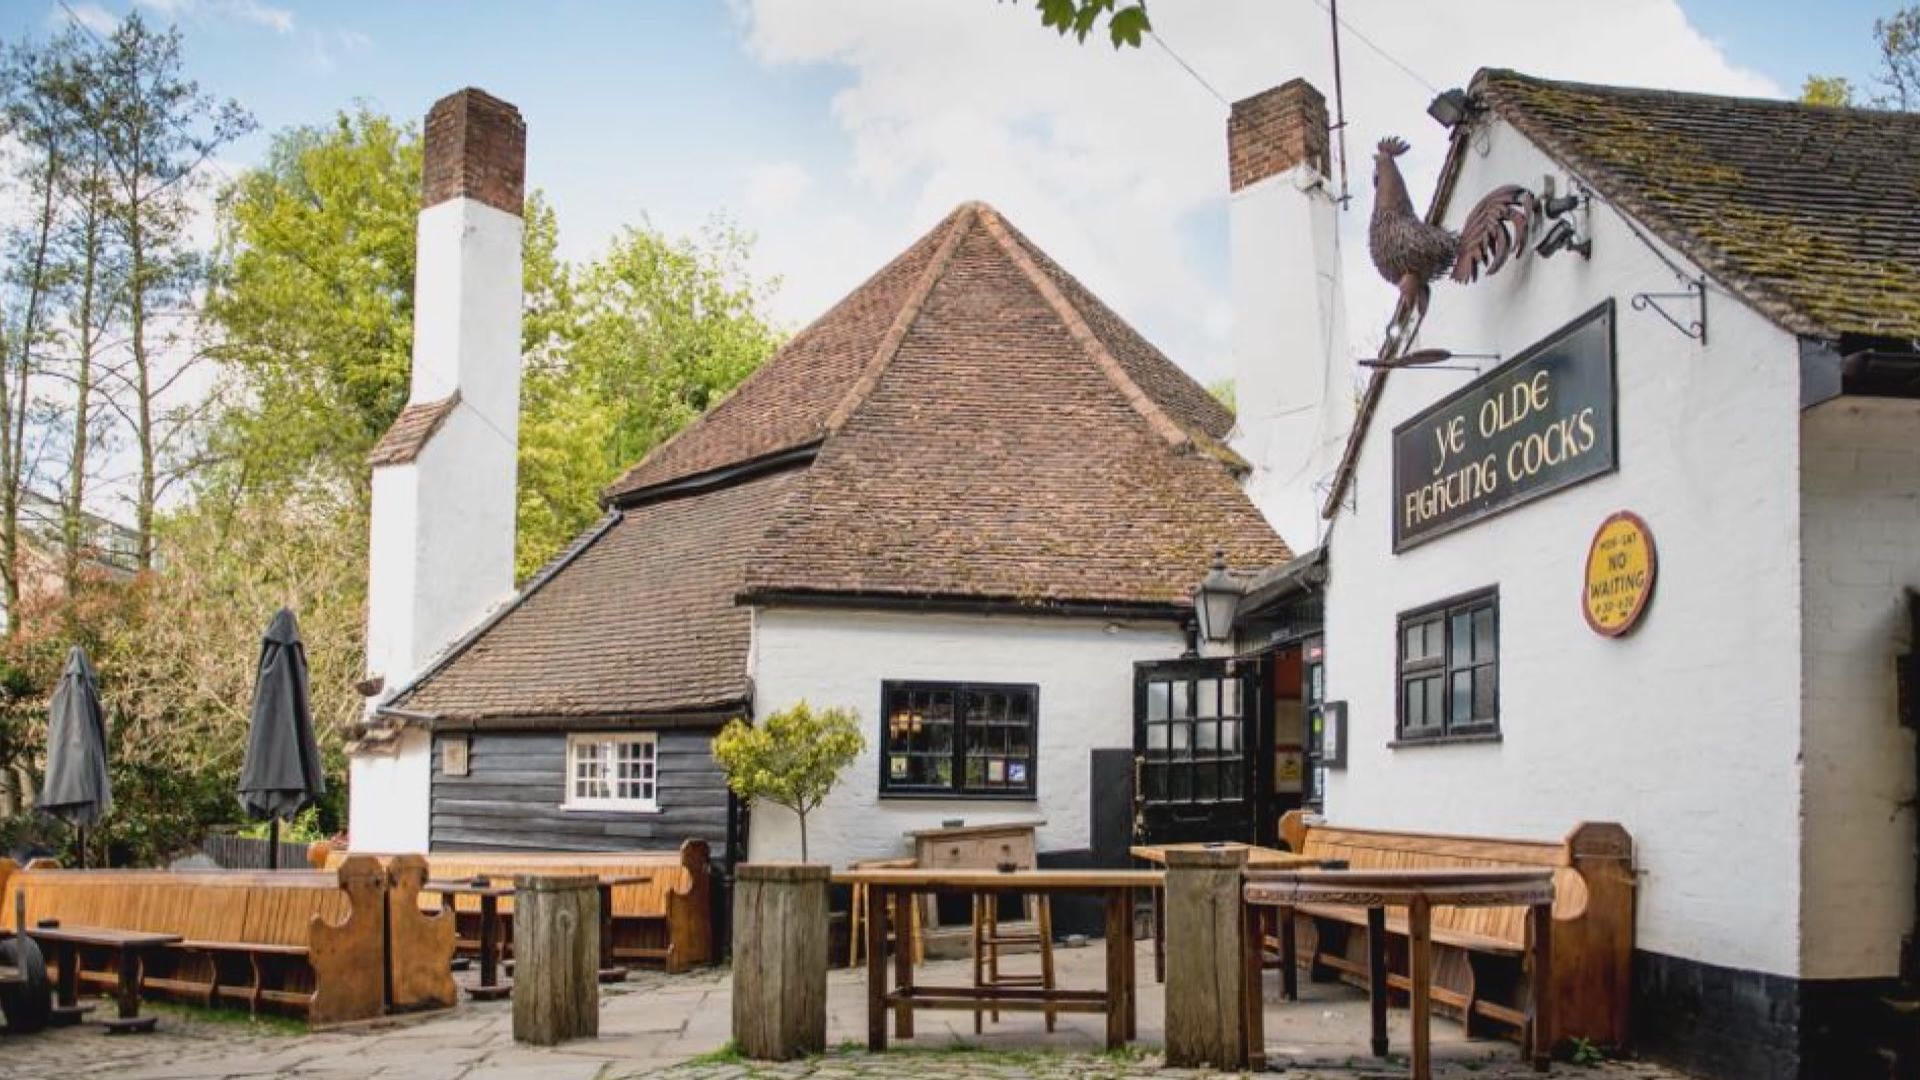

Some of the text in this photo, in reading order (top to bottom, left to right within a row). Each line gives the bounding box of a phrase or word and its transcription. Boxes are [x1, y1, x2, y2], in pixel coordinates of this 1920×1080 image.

[1479, 370, 1550, 439] OLDE
[1507, 407, 1594, 481] COCKS
[1590, 571, 1644, 598] WAITING
[1608, 552, 1626, 570] NO
